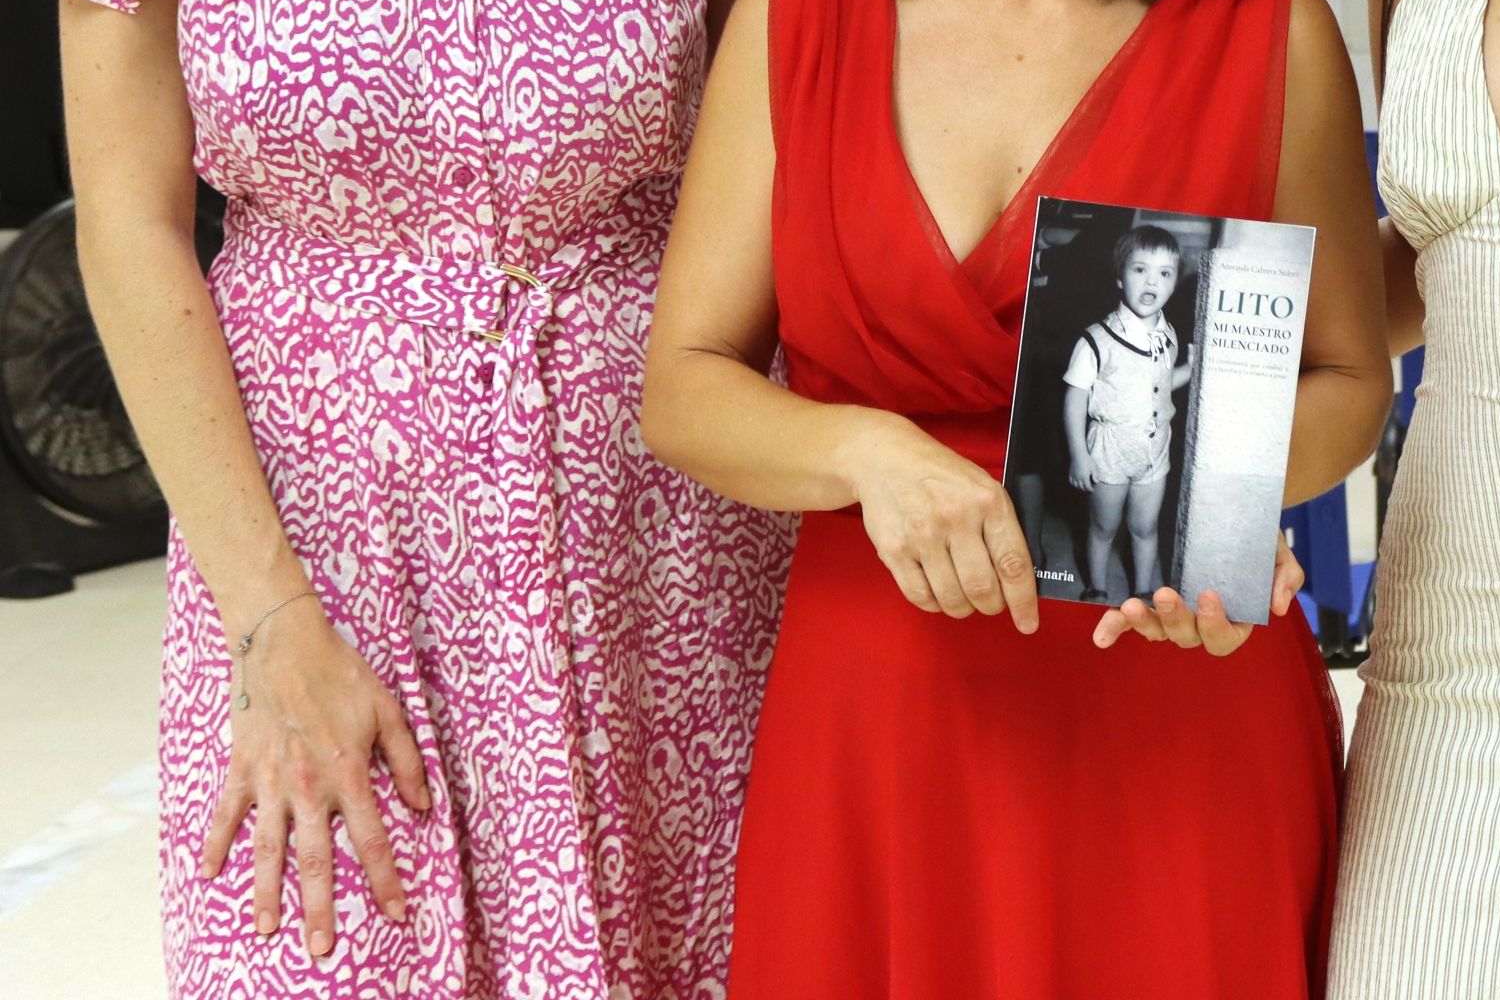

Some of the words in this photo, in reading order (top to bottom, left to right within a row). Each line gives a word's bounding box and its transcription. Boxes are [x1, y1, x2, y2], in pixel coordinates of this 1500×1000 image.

[1217, 289, 1294, 320] LITO
[1214, 322, 1228, 333] MI
[1232, 324, 1292, 340] MAESTRO
[1211, 338, 1290, 355] SILENCIADO
[1033, 566, 1075, 583] anaria
